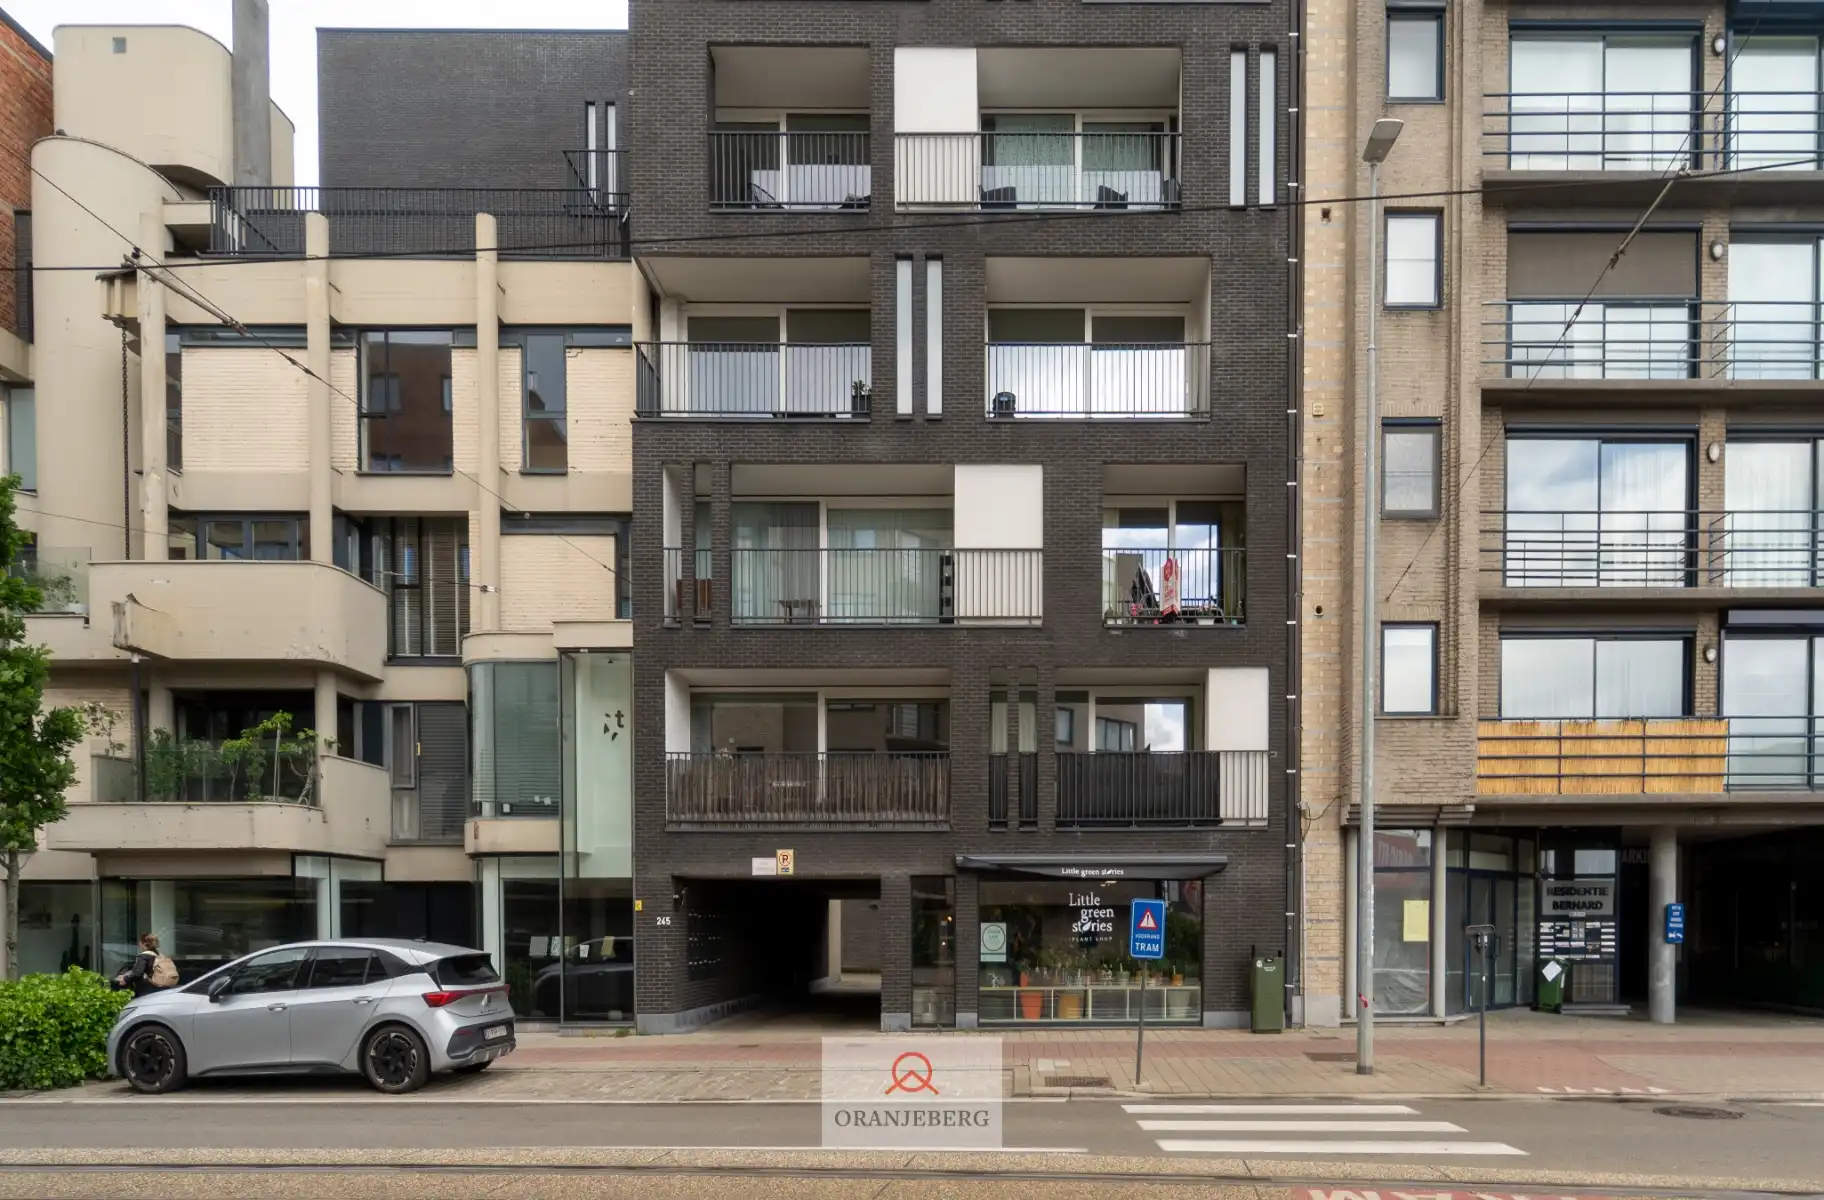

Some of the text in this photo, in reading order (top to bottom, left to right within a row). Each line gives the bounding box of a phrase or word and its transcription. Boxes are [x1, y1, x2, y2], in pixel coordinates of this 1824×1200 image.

[1061, 867, 1080, 875] Little
[1080, 869, 1100, 878] green
[1546, 886, 1609, 896] RESIDENTIE
[1069, 892, 1101, 906] Little
[1552, 900, 1604, 911] BERNARD
[1080, 907, 1114, 923] green
[656, 916, 671, 926] 245
[1072, 920, 1113, 932] stories
[1135, 942, 1160, 952] TRAM
